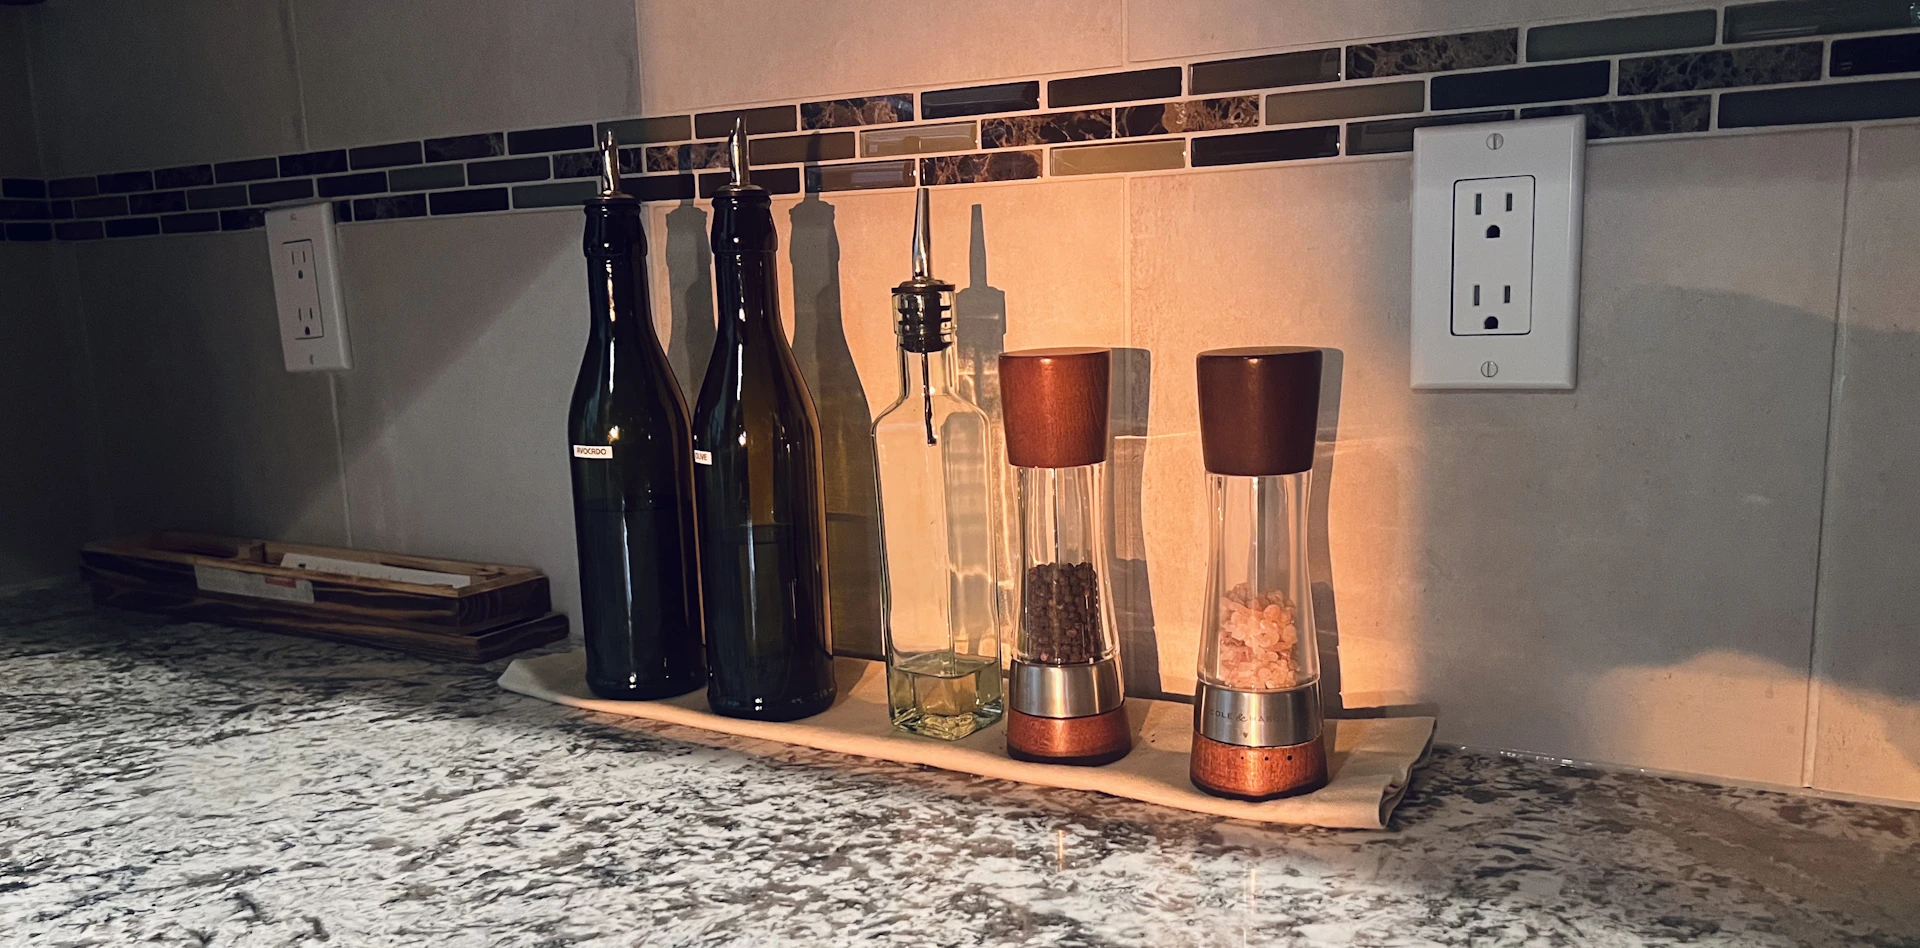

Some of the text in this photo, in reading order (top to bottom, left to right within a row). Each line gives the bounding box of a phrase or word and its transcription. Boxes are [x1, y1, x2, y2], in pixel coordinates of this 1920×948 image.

[576, 447, 607, 455] AVOCADO
[1209, 709, 1232, 720] COLE
[1236, 713, 1248, 723] &
